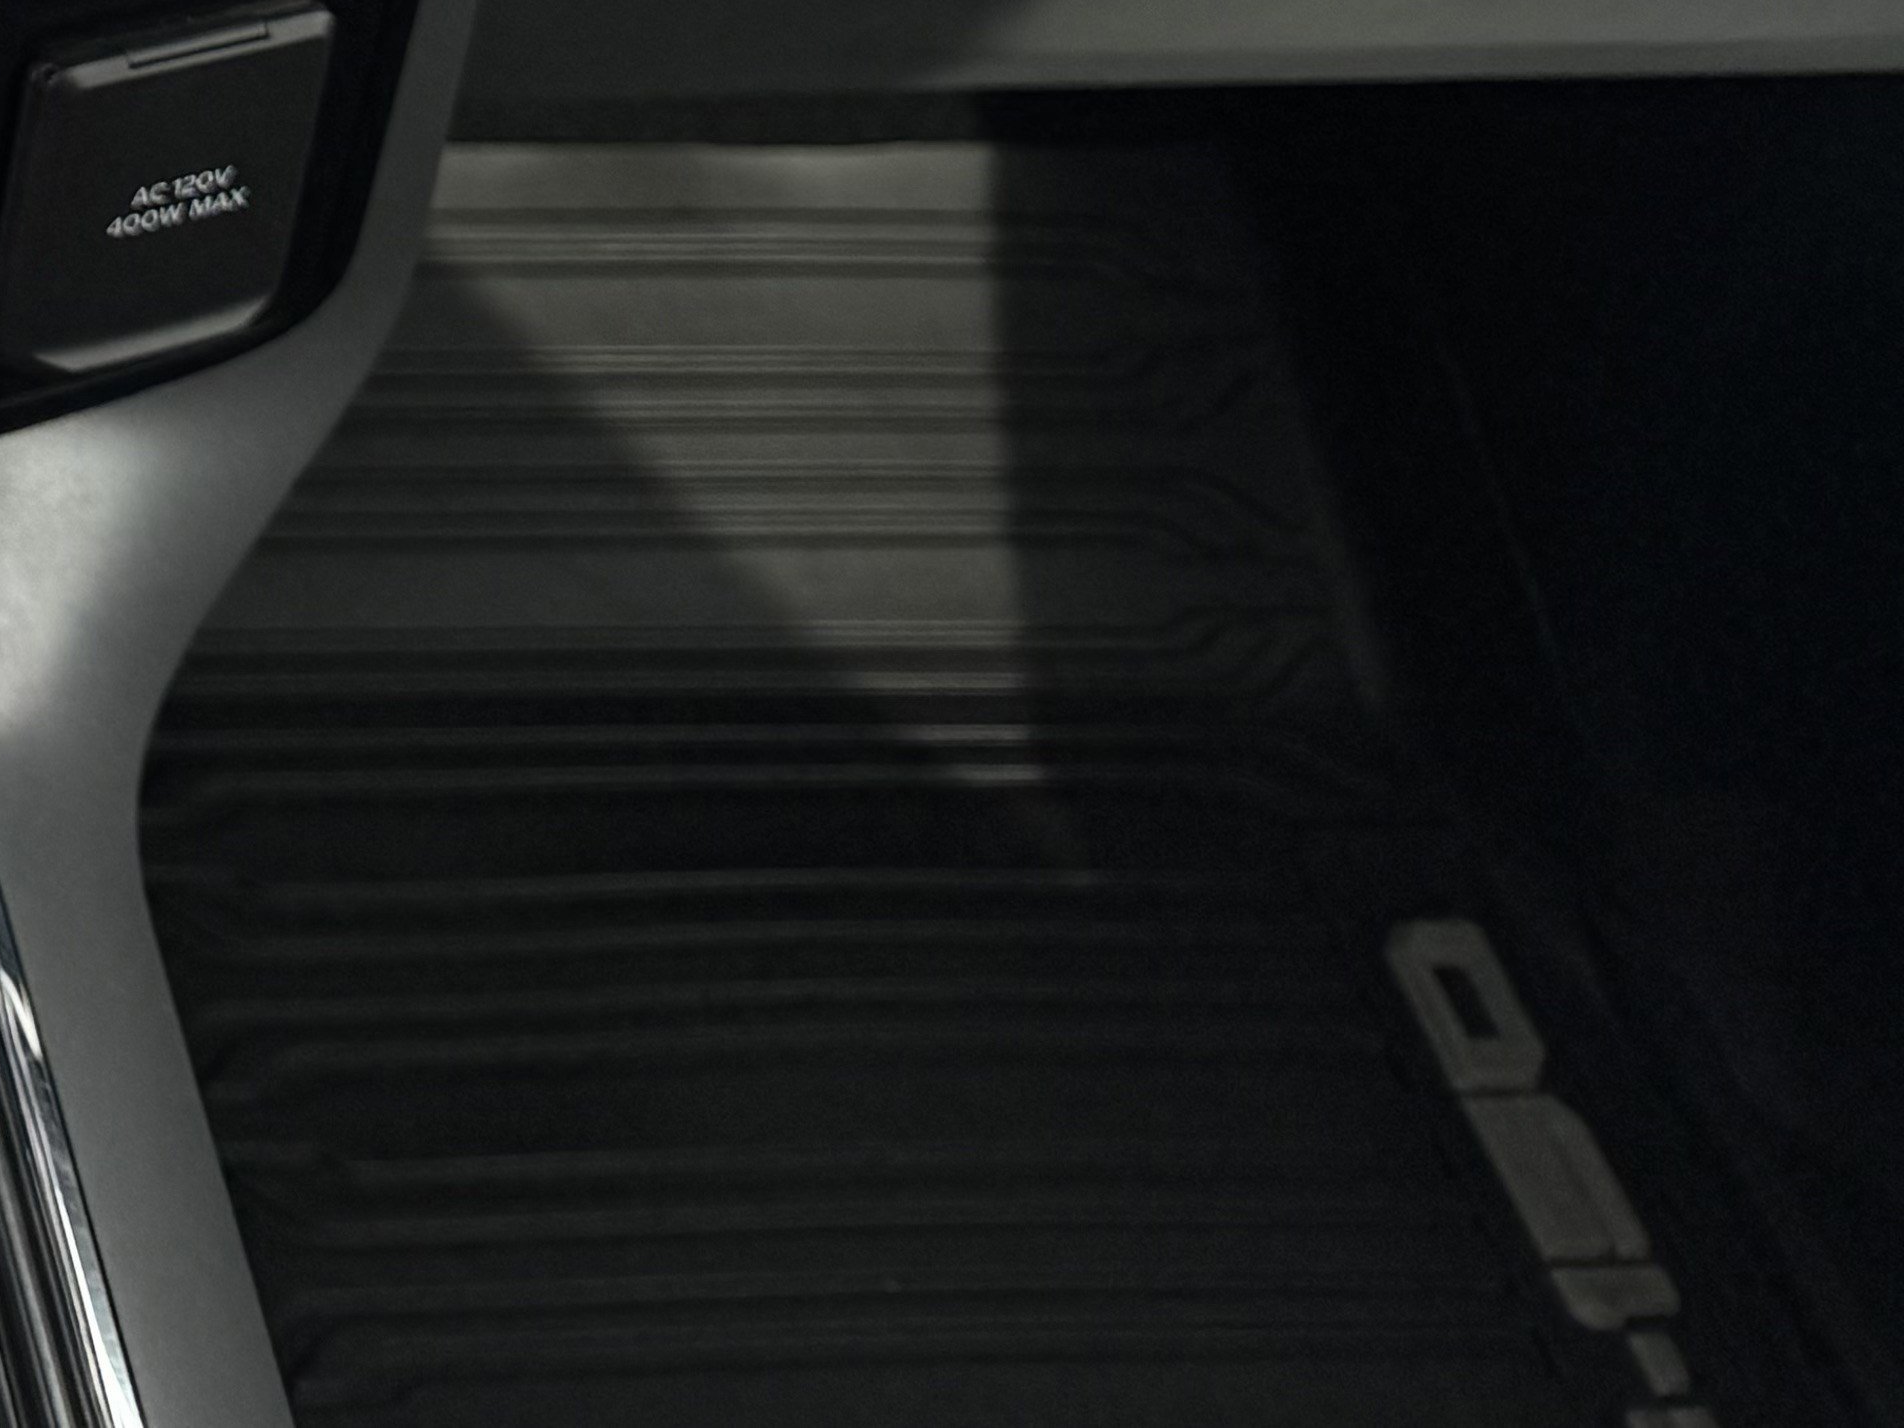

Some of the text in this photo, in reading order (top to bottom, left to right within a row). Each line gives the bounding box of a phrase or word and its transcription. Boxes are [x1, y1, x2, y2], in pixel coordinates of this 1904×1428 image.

[130, 165, 237, 210] AC 120V
[106, 186, 250, 239] 400W MAX
